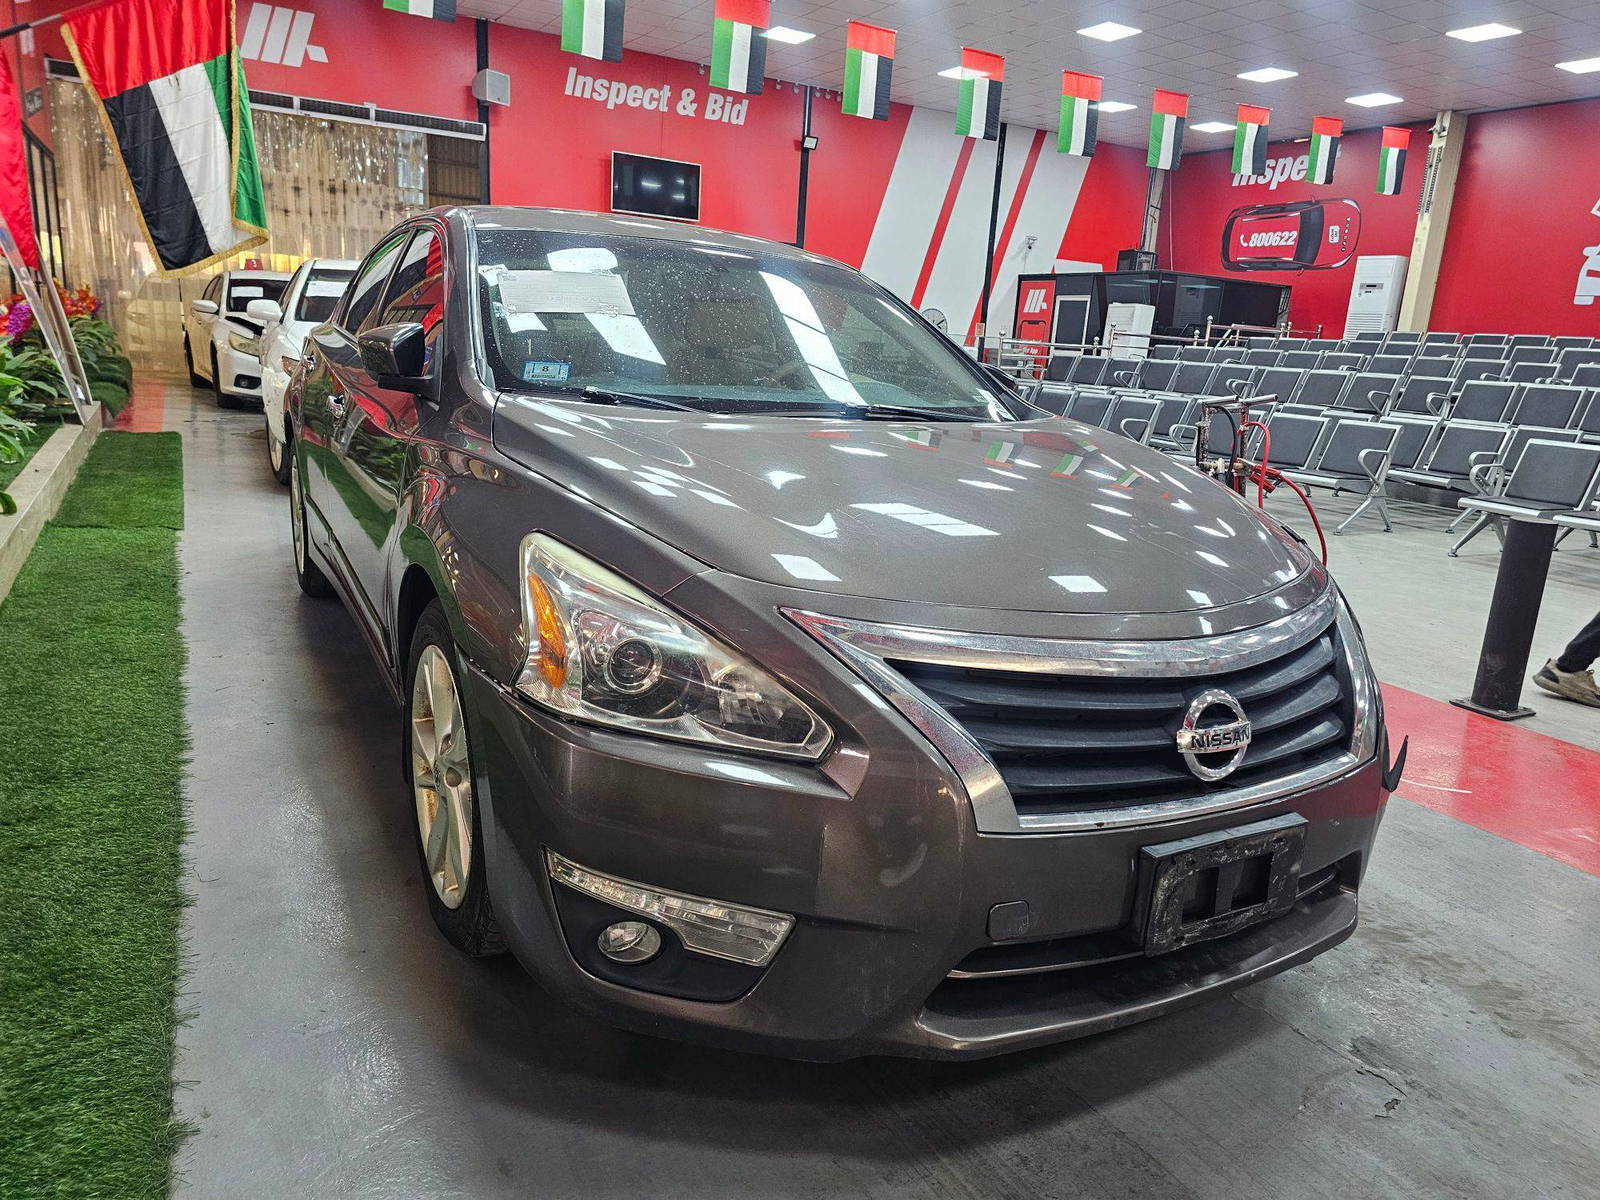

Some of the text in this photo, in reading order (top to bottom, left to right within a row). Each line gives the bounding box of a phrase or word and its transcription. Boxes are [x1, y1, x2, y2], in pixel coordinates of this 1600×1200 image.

[564, 67, 749, 126] Inspect & Bid
[1249, 231, 1298, 247] 800622
[1191, 723, 1251, 749] NISSAN
